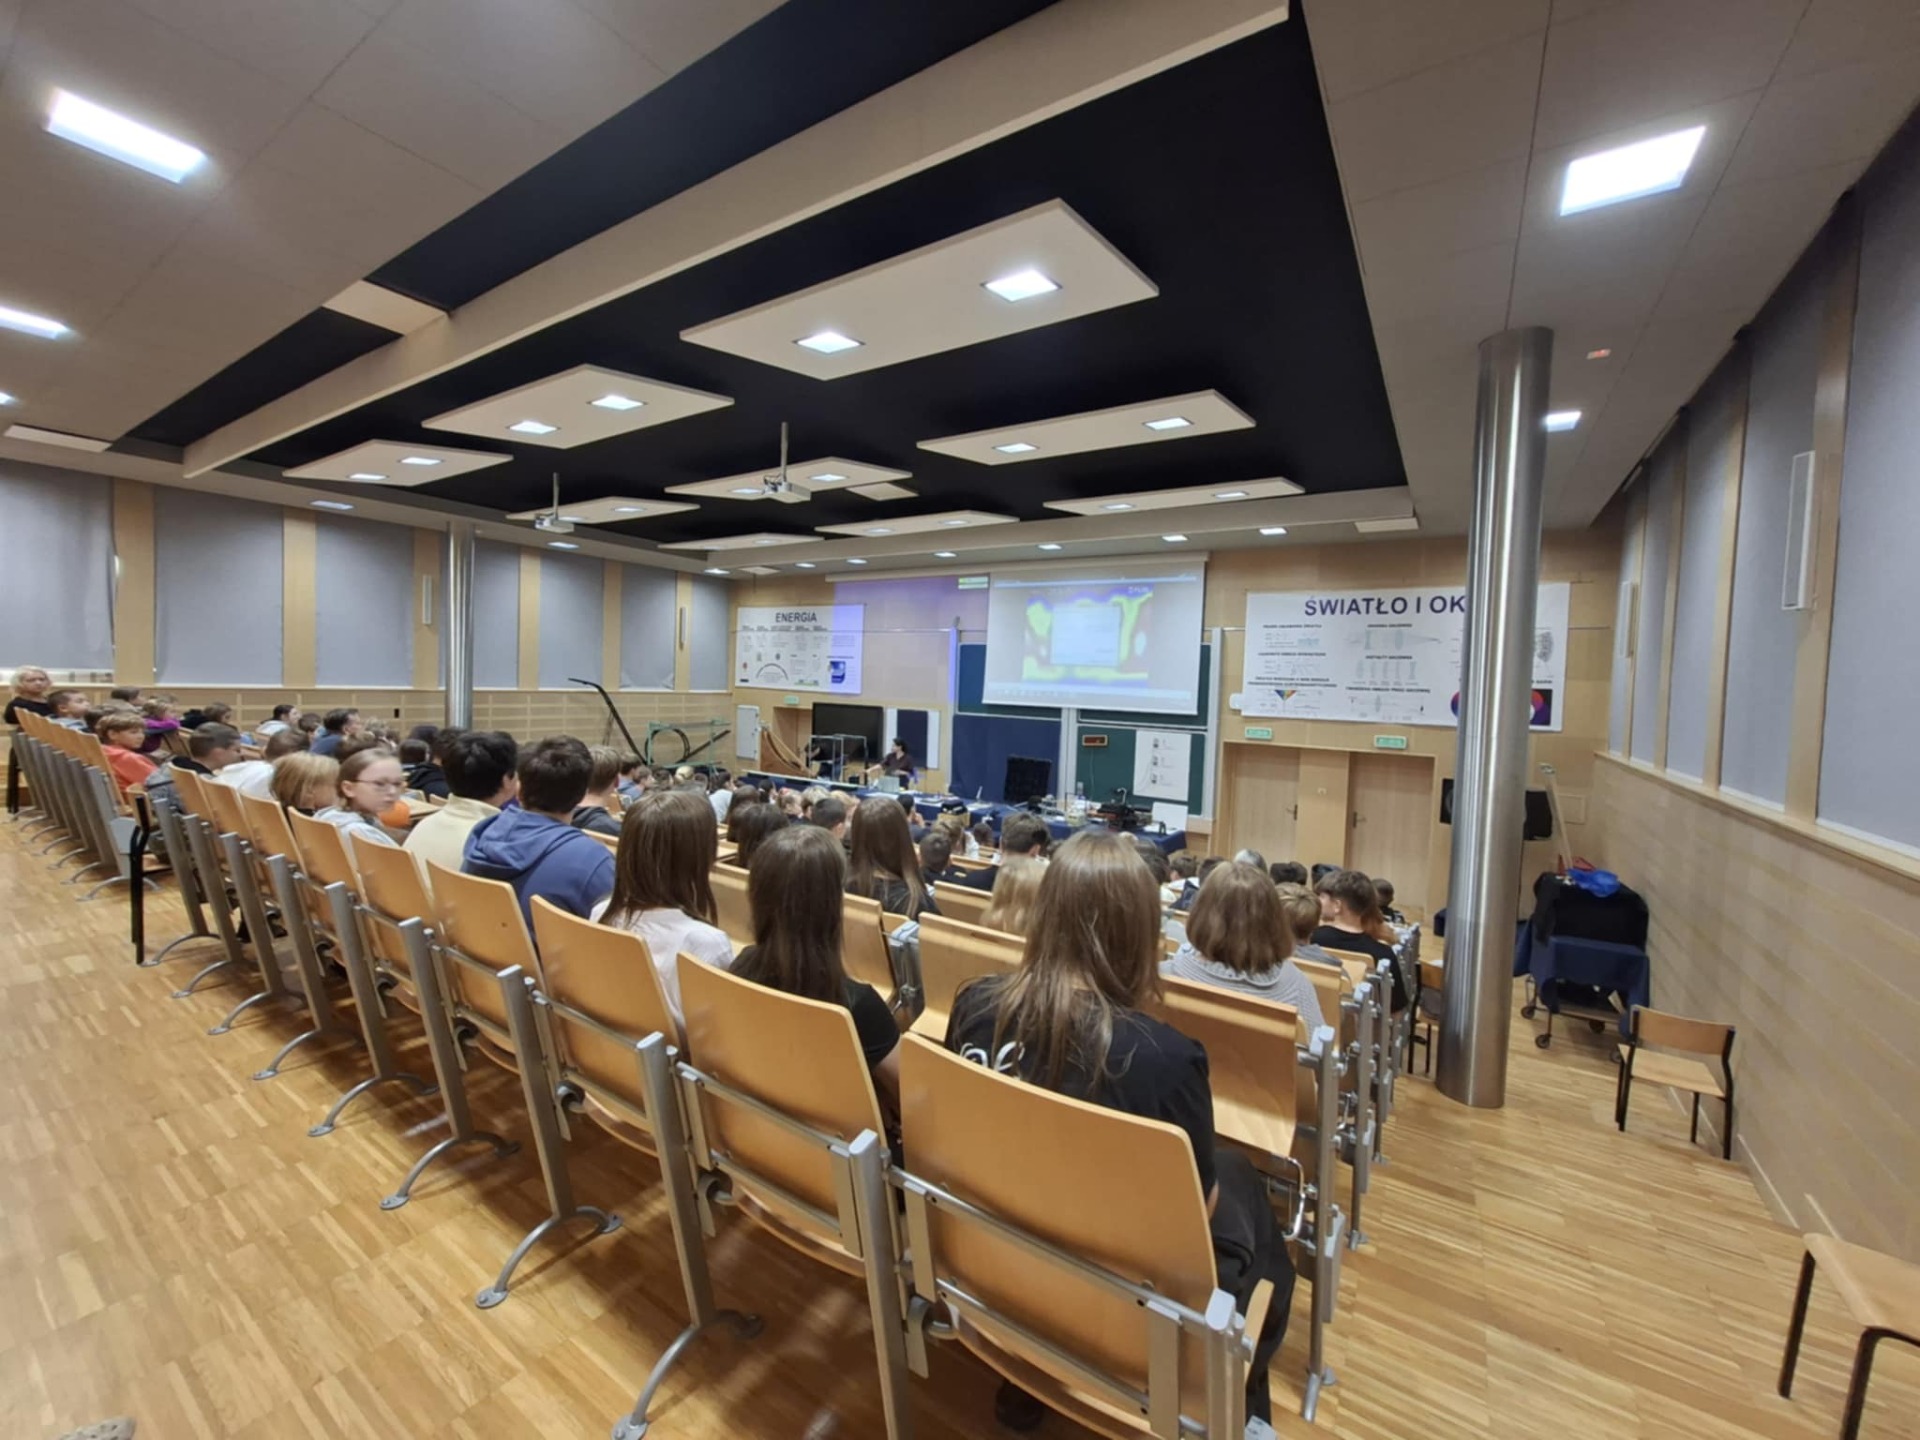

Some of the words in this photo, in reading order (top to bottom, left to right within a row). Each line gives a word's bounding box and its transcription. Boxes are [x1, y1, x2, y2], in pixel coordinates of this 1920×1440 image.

[1304, 596, 1408, 616] ŚWIATŁO
[1416, 596, 1421, 614] I
[1429, 595, 1466, 614] OK
[775, 612, 818, 623] ENERGIA
